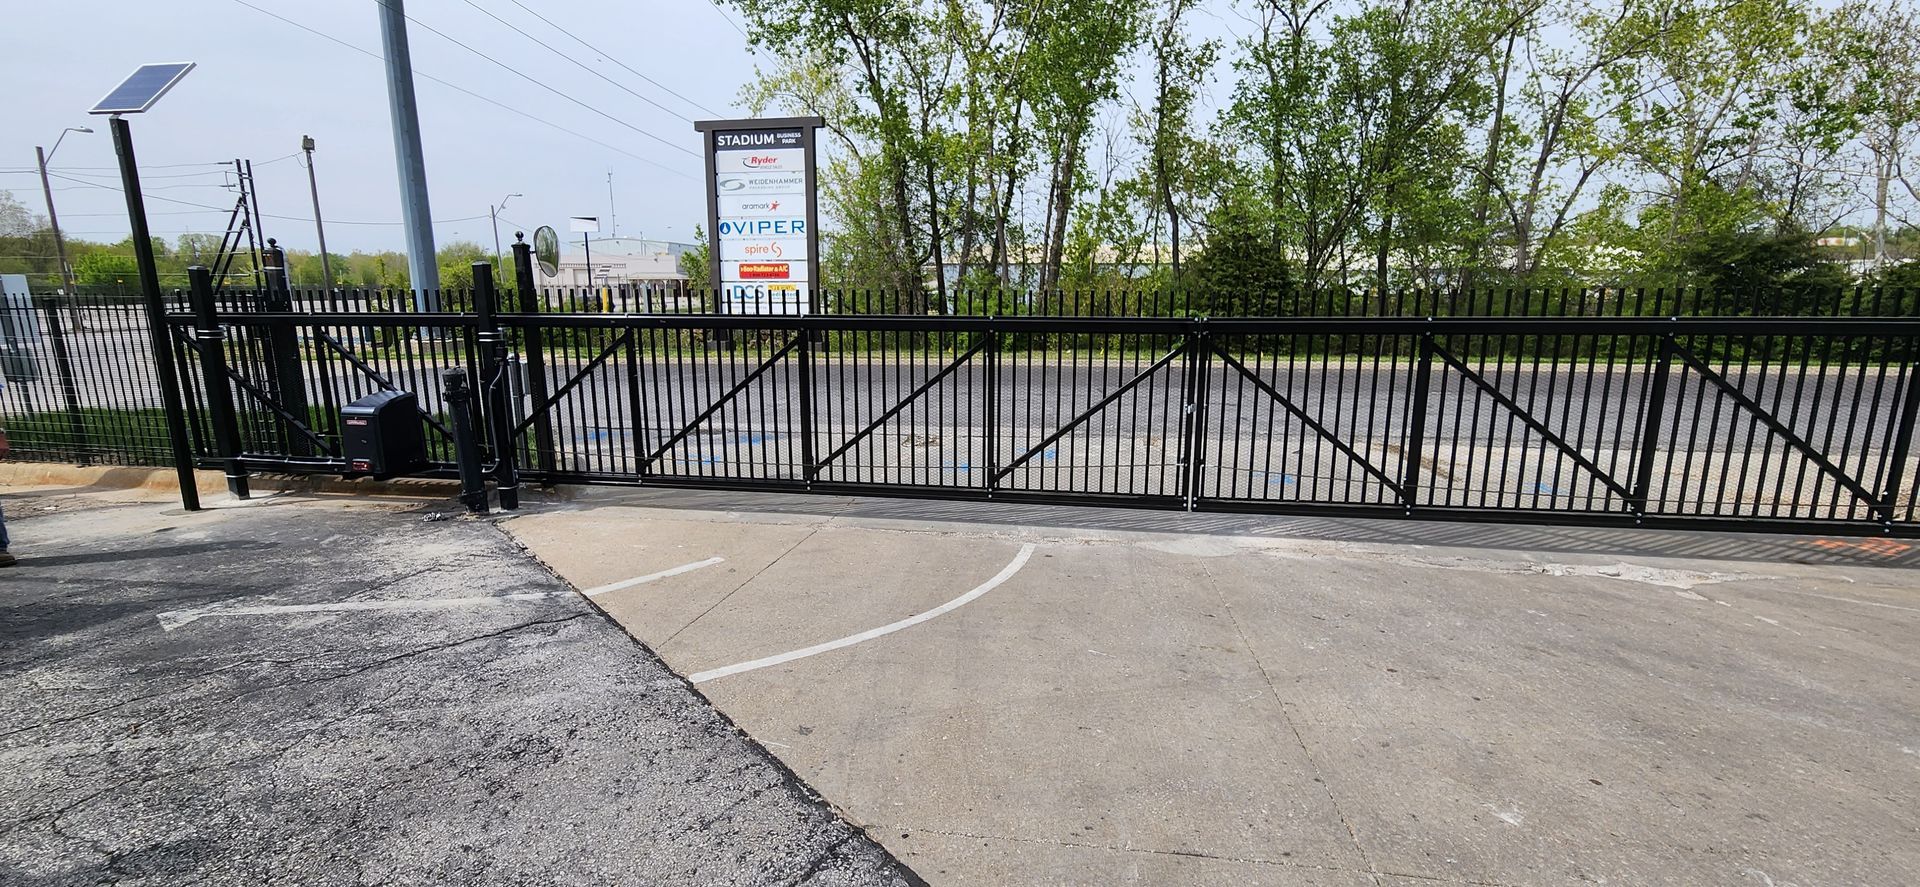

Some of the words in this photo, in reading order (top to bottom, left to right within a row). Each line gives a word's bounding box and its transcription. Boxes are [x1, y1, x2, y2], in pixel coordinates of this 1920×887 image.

[717, 133, 775, 146] STADIUM
[751, 156, 778, 165] Ryder
[733, 220, 805, 235] VIPER
[745, 244, 769, 255] spire
[733, 285, 765, 300] DCS
